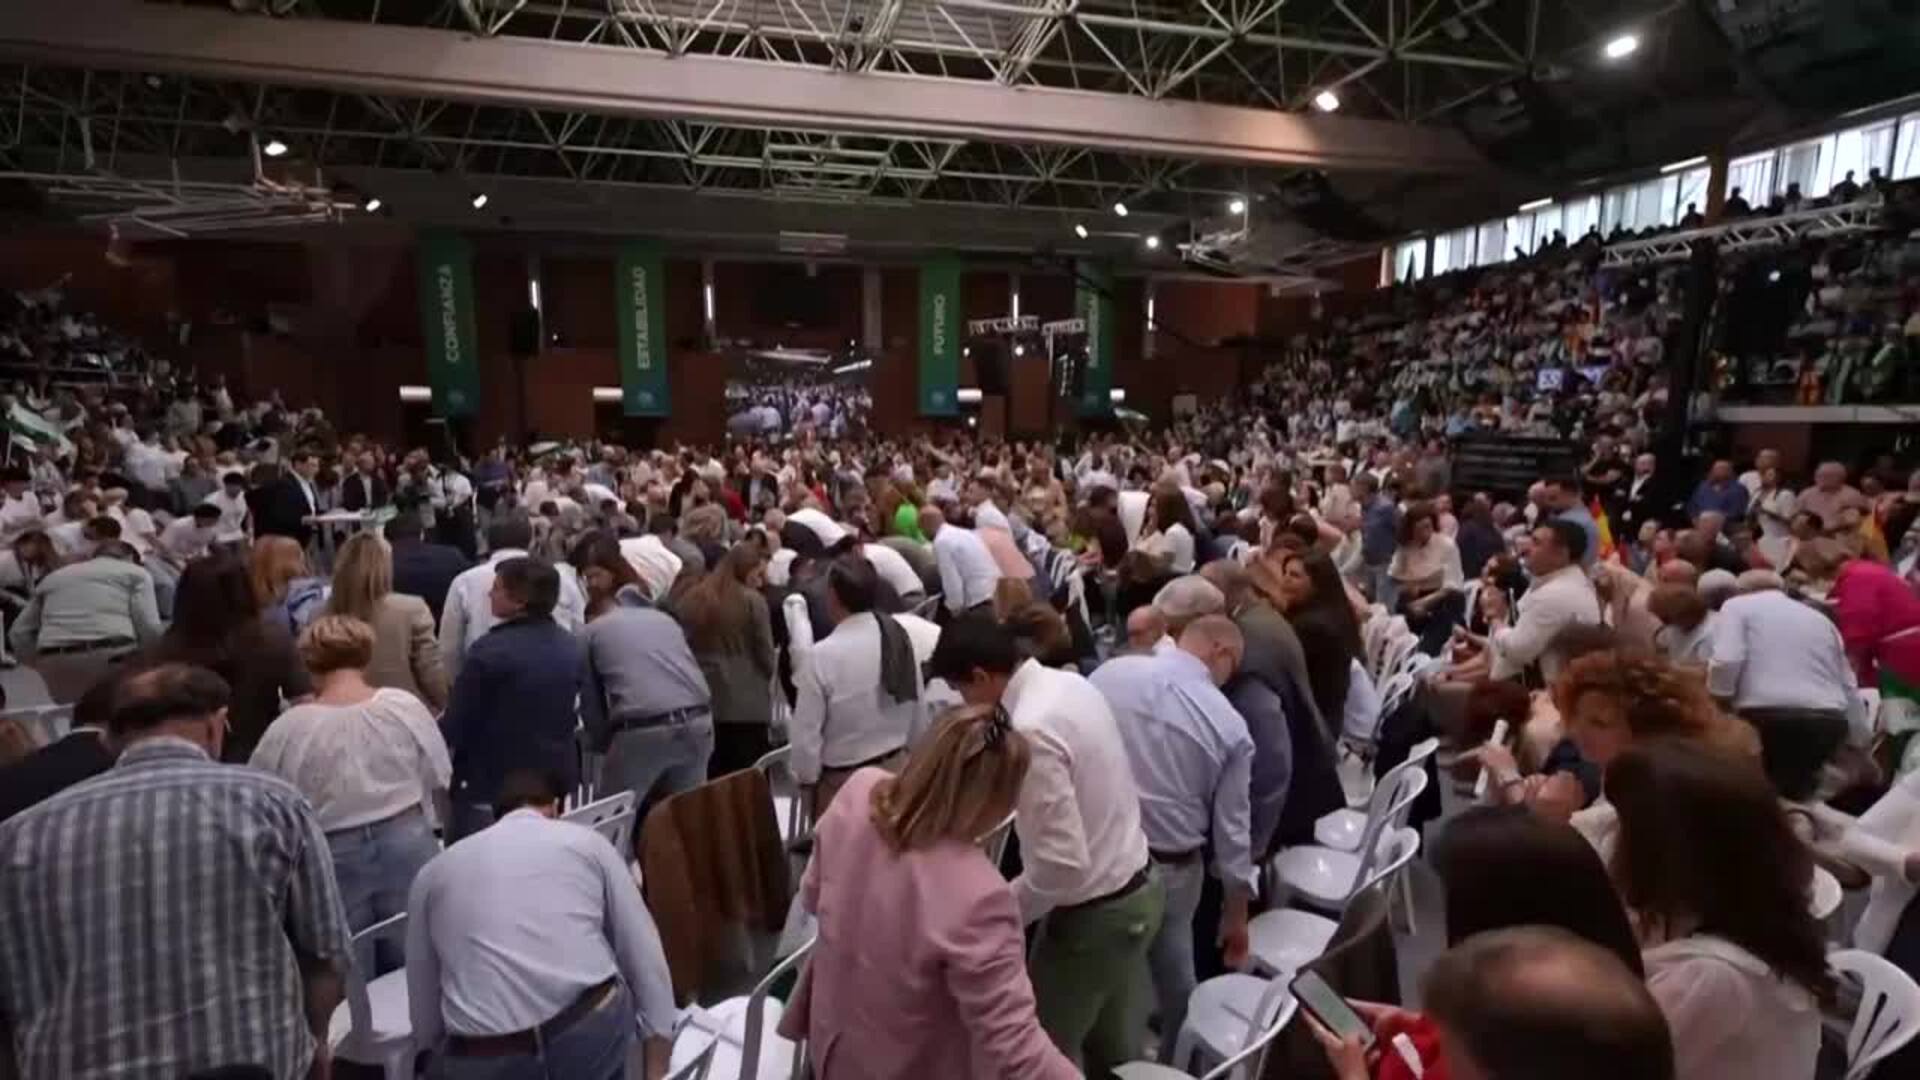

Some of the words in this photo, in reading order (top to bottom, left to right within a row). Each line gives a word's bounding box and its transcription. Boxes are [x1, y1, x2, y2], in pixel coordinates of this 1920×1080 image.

[437, 264, 461, 363] CONFIANZA
[631, 266, 651, 370] ESTABILIDAD
[932, 293, 947, 356] FUTURO
